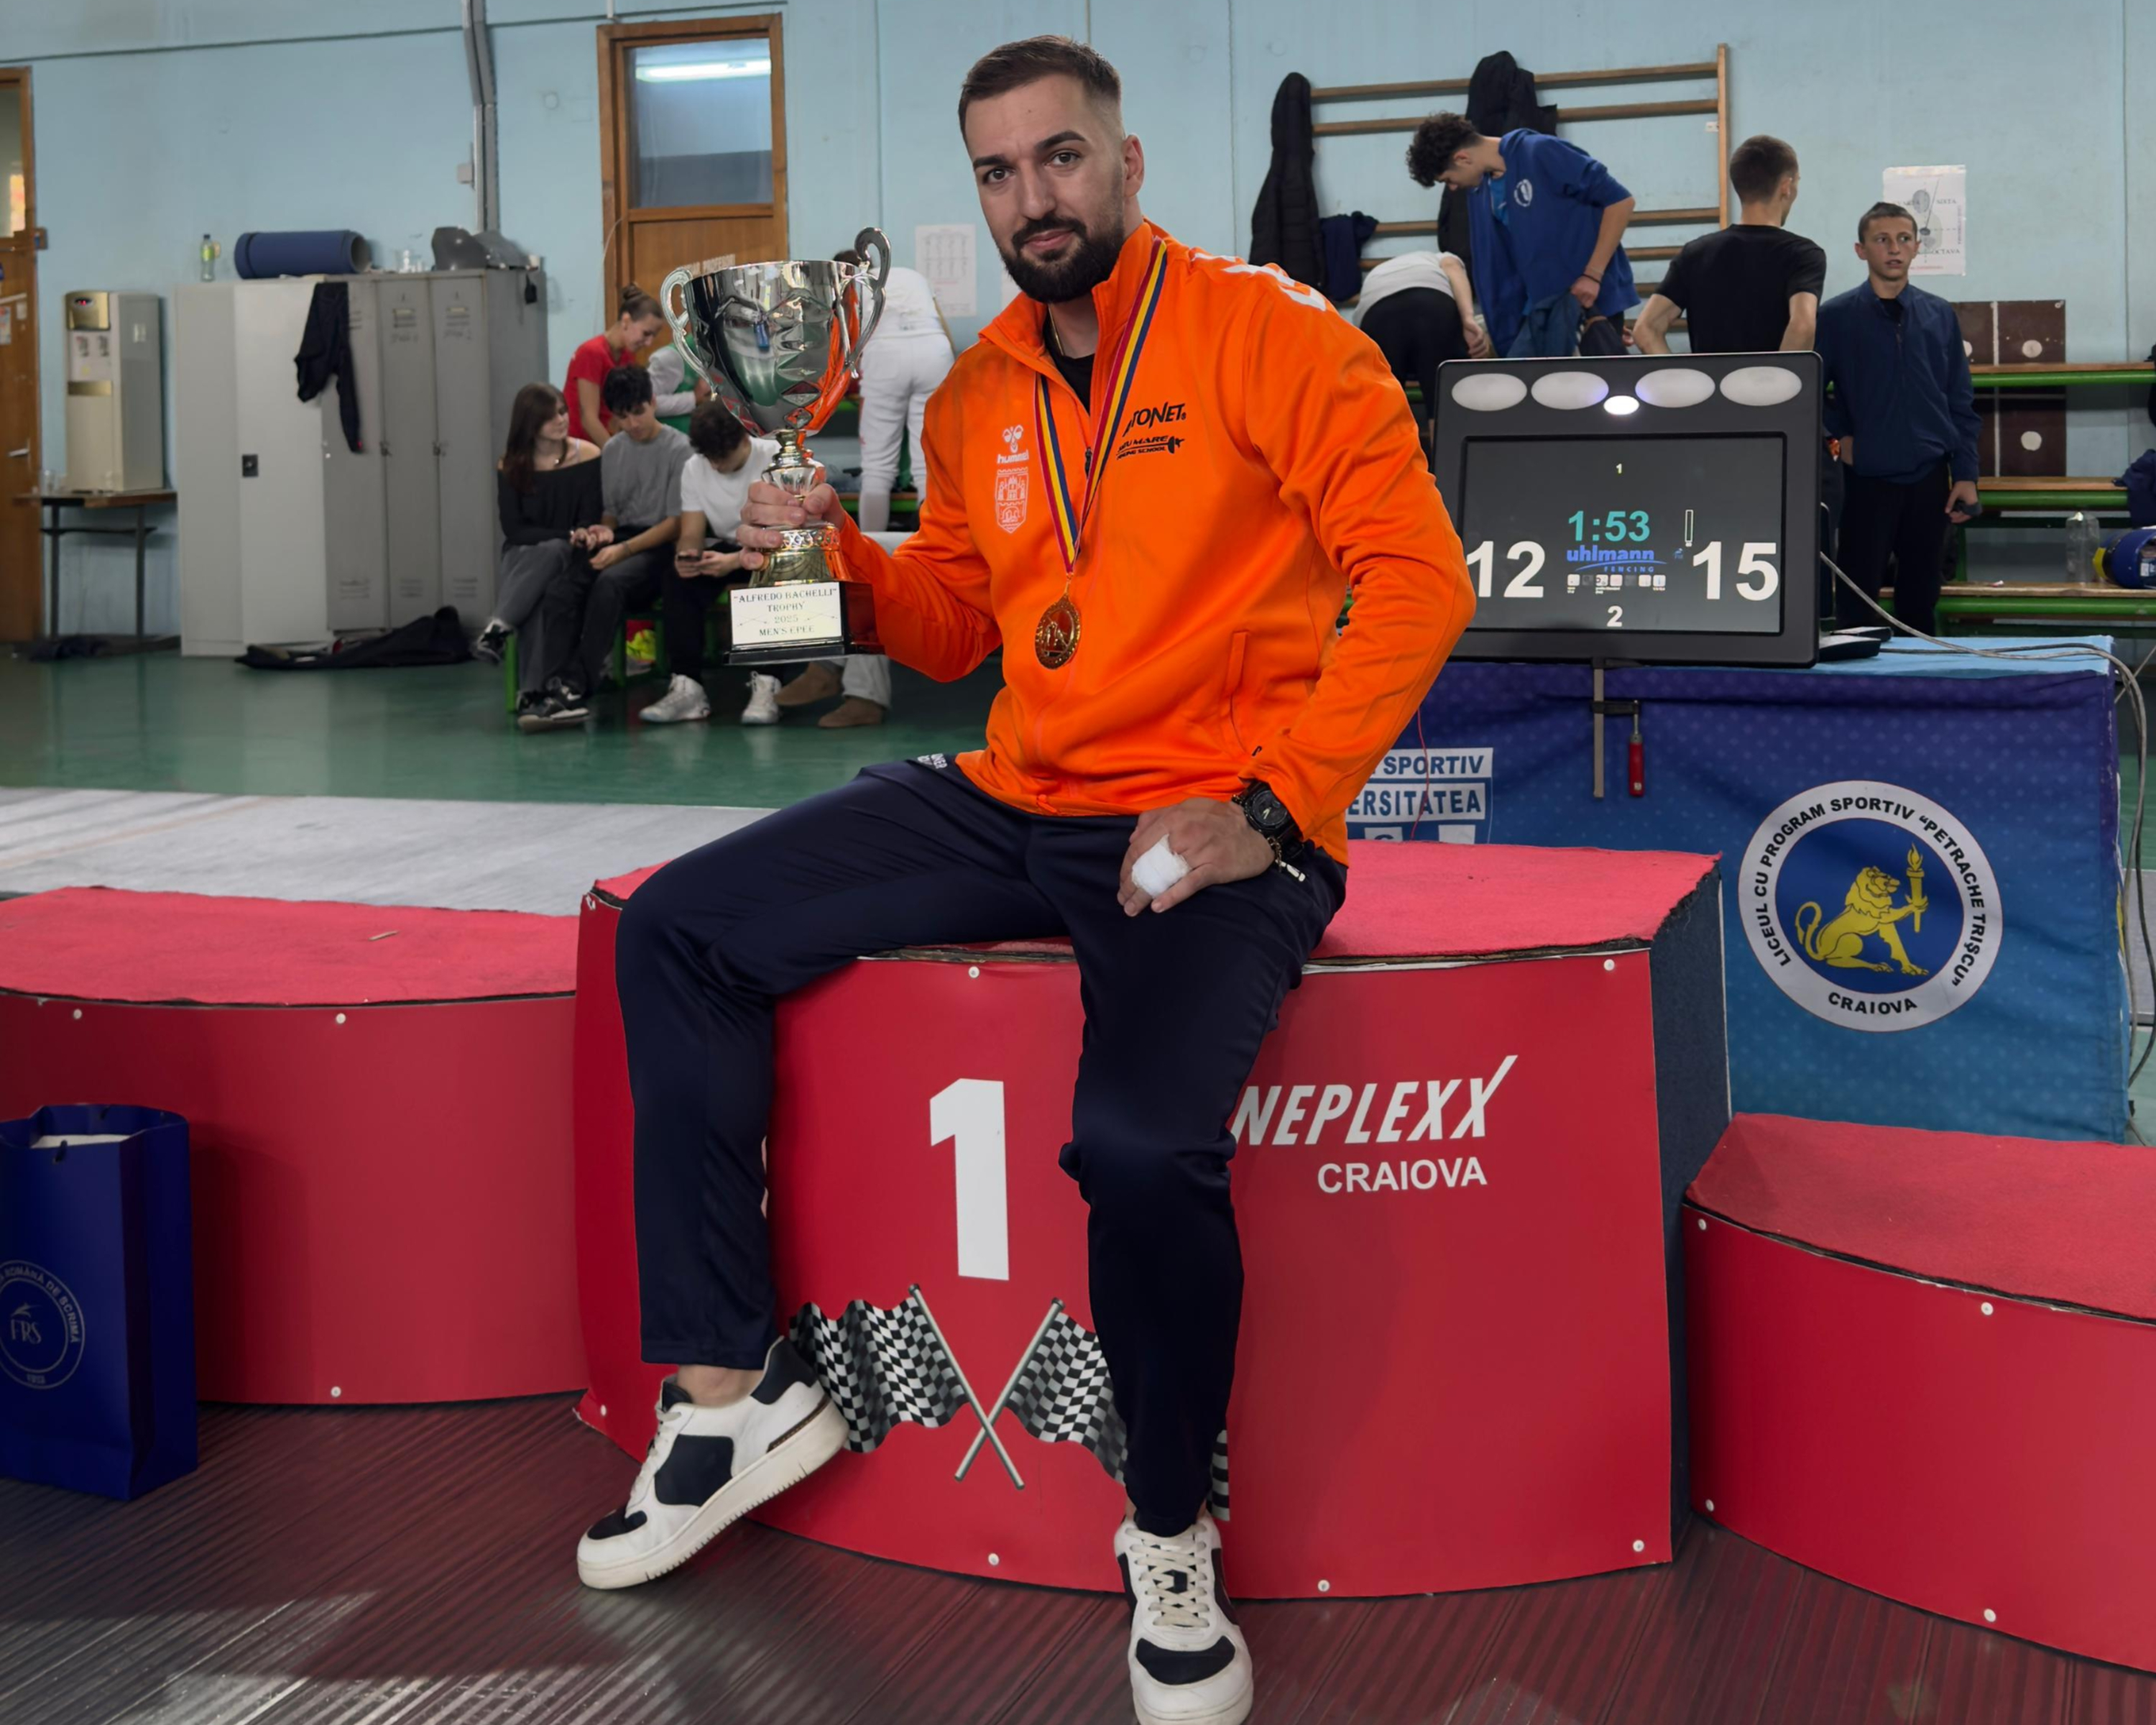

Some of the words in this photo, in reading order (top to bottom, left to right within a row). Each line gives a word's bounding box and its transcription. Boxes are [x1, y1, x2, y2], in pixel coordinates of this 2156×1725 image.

[997, 449, 1029, 464] hummel
[1616, 464, 1623, 474] 1
[1567, 510, 1650, 542] 1:53
[1567, 545, 1655, 562] uhlmann
[1465, 541, 1547, 598] 12
[1692, 541, 1779, 601] 15
[767, 602, 805, 612] TROPHY
[1606, 606, 1623, 627] 2
[774, 614, 798, 624] 2025
[759, 627, 787, 637] MEN'S
[1383, 755, 1485, 775] SPORTIV
[1830, 796, 1915, 820] SPORTIV
[1760, 804, 1826, 868] PROGRAM
[1754, 872, 1769, 897] CU
[1756, 903, 1792, 966] LICEUL
[1828, 992, 1918, 1015] CRAIOVA
[1230, 1054, 1519, 1146] NEPLEXX
[929, 1078, 1010, 1282] 1
[1317, 1156, 1488, 1194] CRAIOVA
